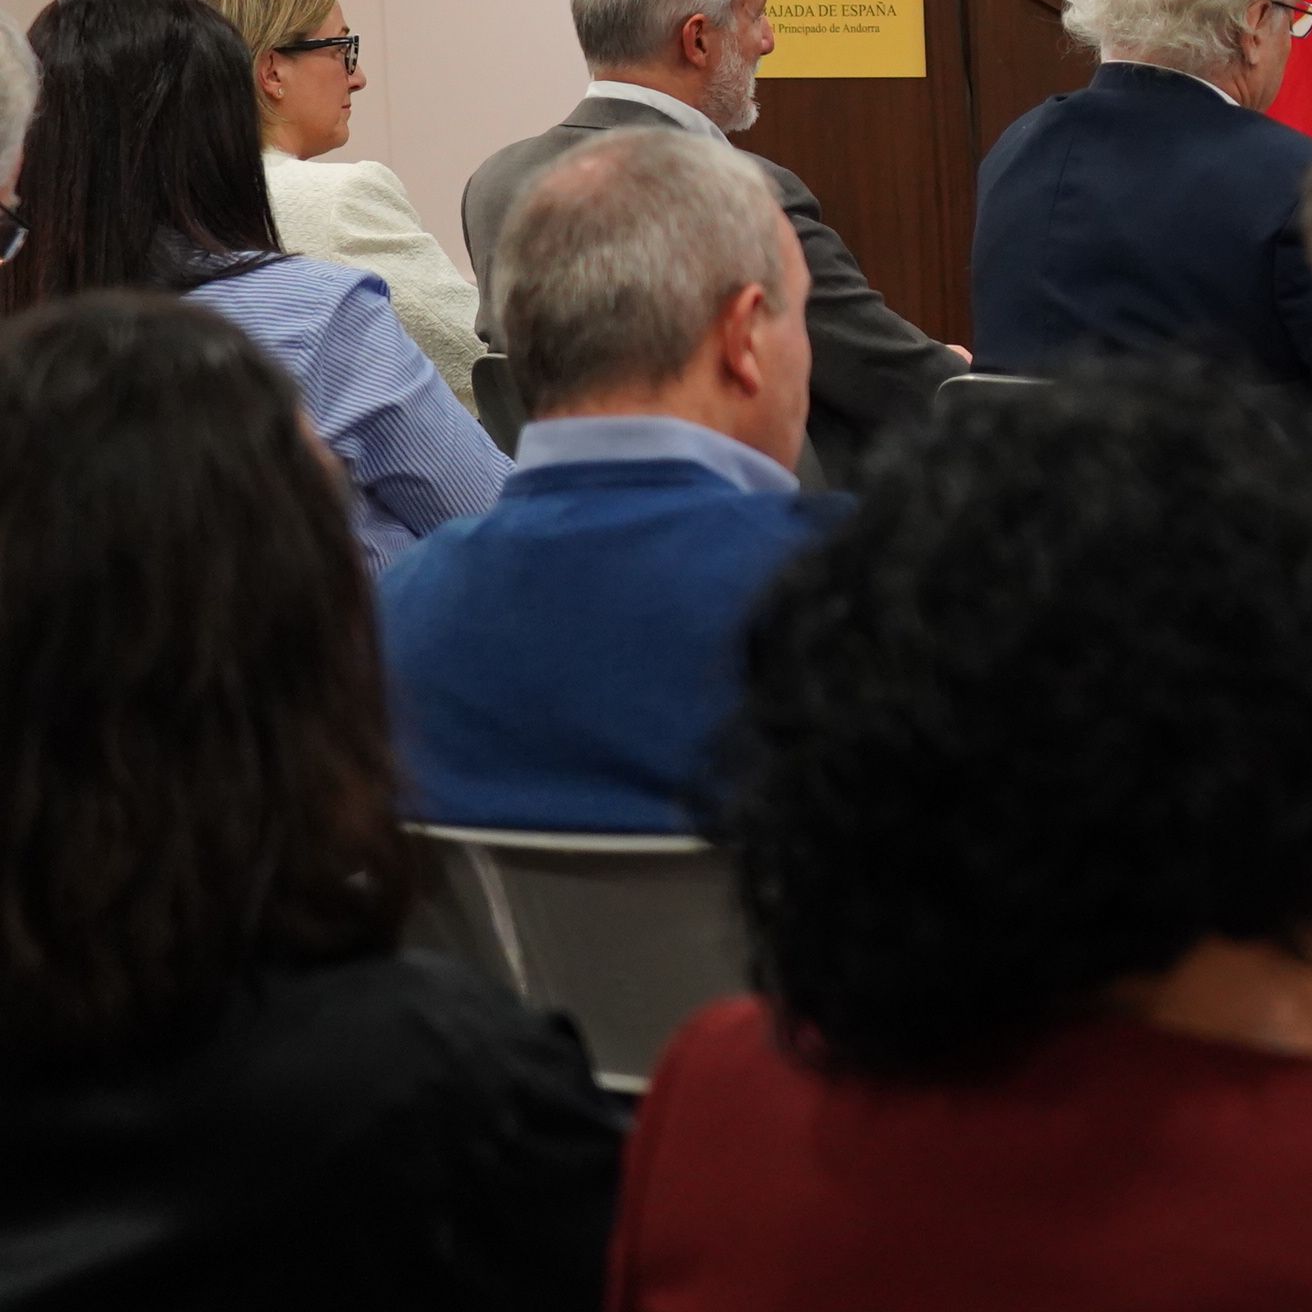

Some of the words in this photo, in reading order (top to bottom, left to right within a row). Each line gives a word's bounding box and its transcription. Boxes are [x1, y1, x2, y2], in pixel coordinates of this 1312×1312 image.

[818, 4, 838, 17] DE
[841, 0, 898, 17] ESPAÑA
[778, 23, 827, 36] Principado
[829, 23, 841, 34] de
[843, 23, 880, 34] Andorra
